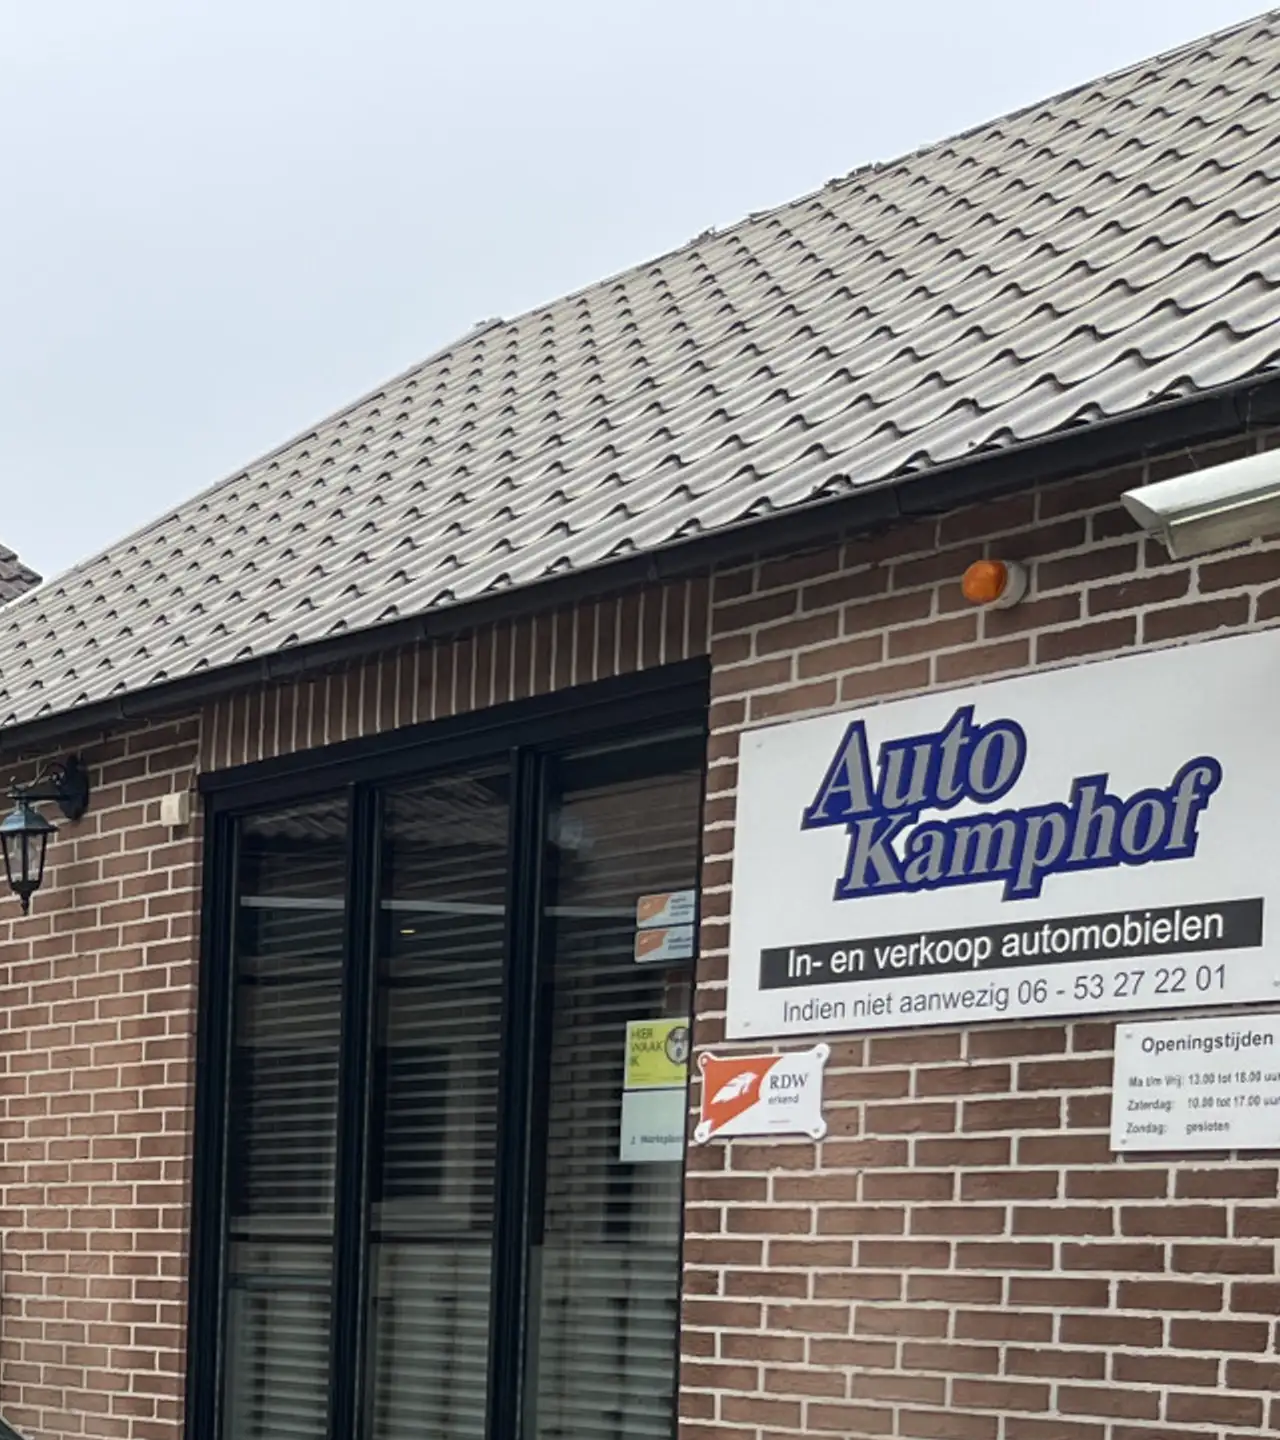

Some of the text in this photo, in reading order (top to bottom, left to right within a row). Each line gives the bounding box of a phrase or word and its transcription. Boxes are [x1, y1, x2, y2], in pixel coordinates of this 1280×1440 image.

[804, 708, 1024, 826] Auto
[837, 759, 1219, 897] Kamphof
[787, 910, 1224, 978] In- en verkoop automobielen
[783, 997, 846, 1023] Indien
[853, 992, 893, 1016] niet
[899, 983, 1010, 1012] aanwezig
[1017, 978, 1048, 1005] 06
[1073, 974, 1105, 1000] 53
[1113, 970, 1146, 997] 27
[1154, 967, 1187, 994] 22
[1195, 963, 1226, 990] 01
[1141, 1030, 1274, 1056] Openingstijden
[769, 1073, 809, 1089] RDW
